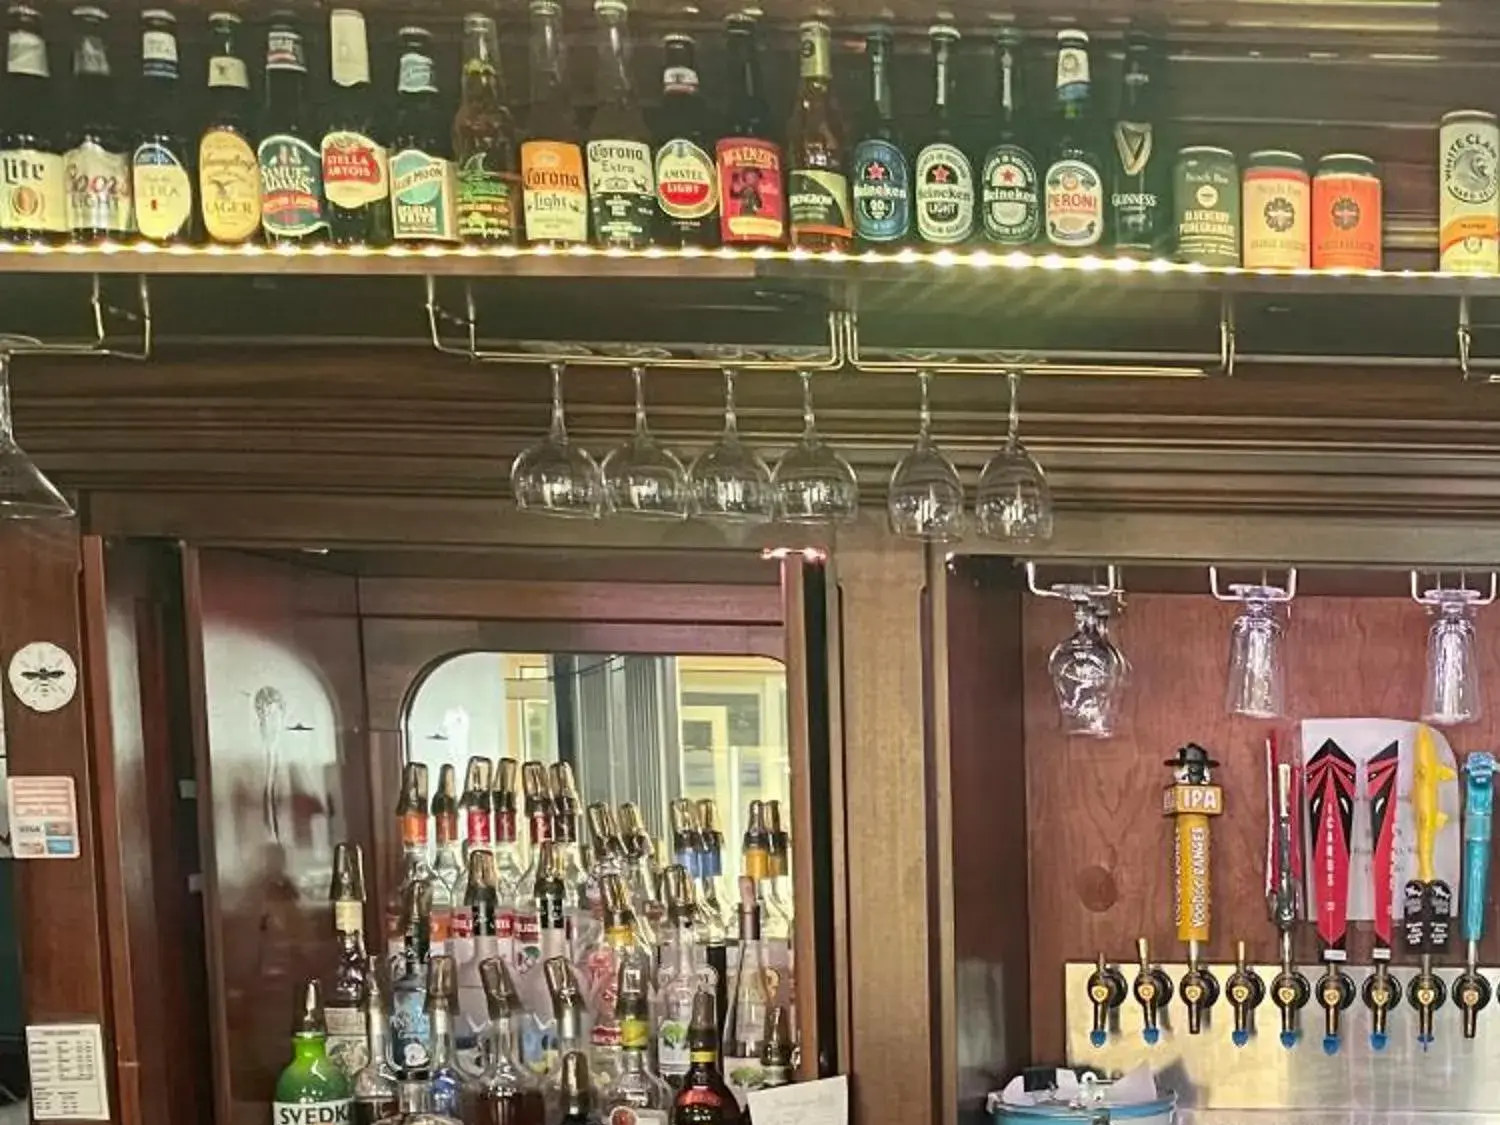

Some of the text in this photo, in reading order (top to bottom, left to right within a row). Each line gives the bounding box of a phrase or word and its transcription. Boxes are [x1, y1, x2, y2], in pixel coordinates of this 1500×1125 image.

[327, 155, 370, 165] STELLA
[589, 143, 644, 163] Corona
[3, 158, 46, 185] Lite
[327, 165, 371, 177] ARTOIS
[601, 160, 635, 173] Extra
[525, 167, 582, 190] Corona
[664, 168, 703, 180] AMSTEL
[666, 183, 701, 194] LIGHT
[1047, 193, 1097, 209] PERONI
[1111, 193, 1157, 207] GUINNESS
[1183, 790, 1217, 809] IPA
